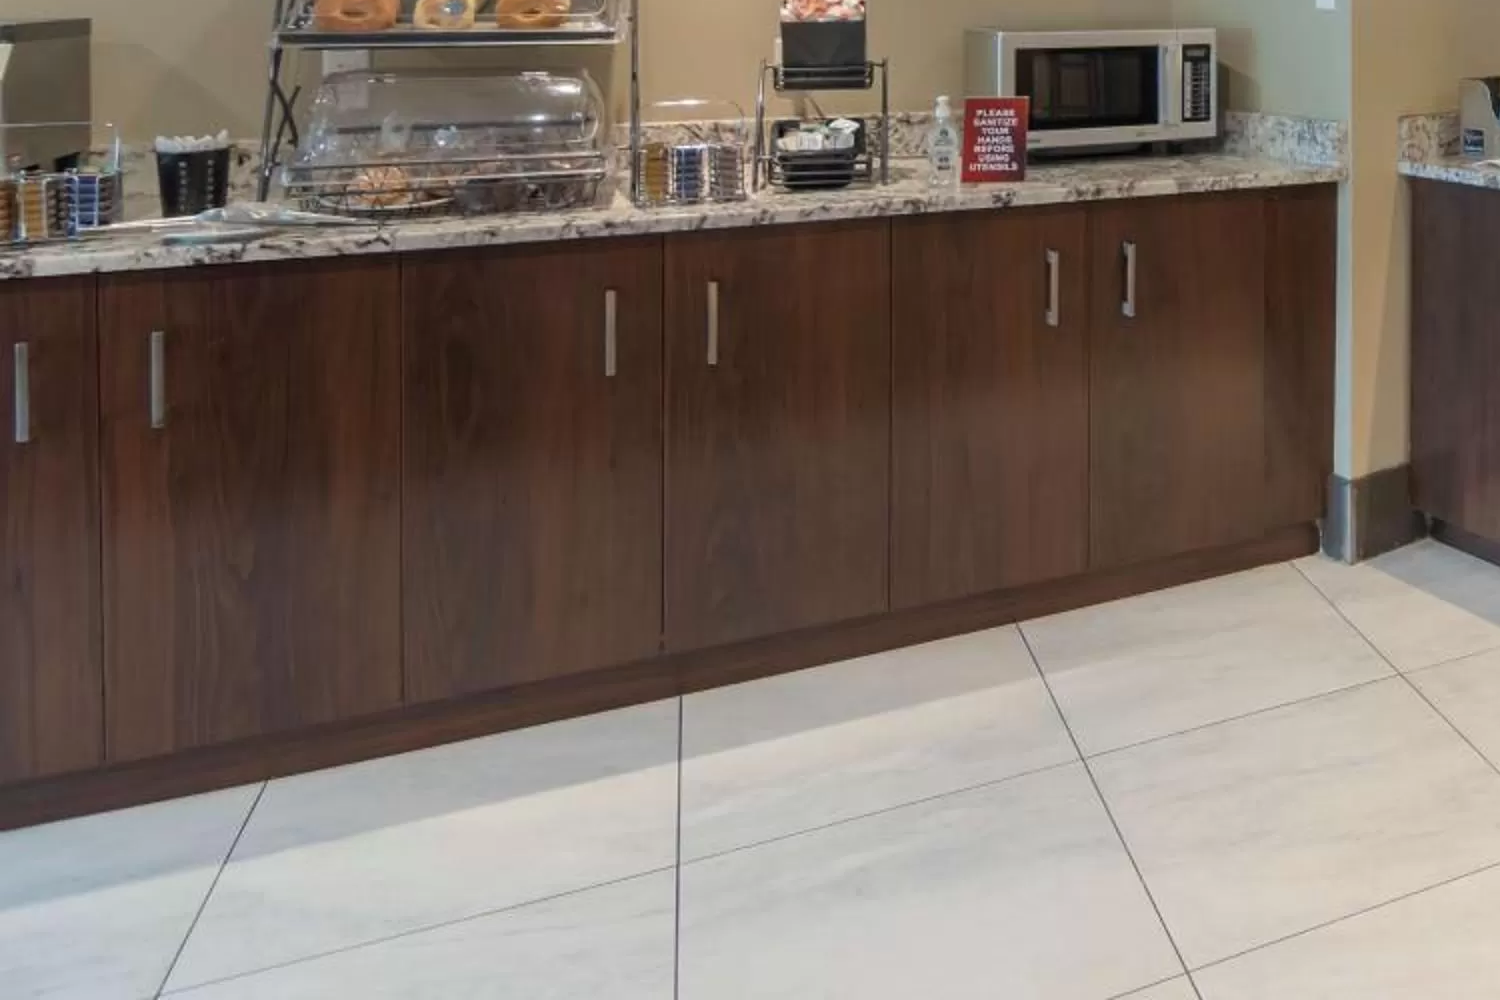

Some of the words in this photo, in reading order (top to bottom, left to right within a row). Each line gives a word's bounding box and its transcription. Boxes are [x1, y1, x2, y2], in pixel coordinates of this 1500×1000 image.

[975, 109, 1016, 117] PLEASE
[972, 118, 1018, 127] SANITIZE
[981, 127, 1010, 135] YOUR
[977, 136, 1013, 144] HANDS
[973, 145, 1014, 153] BEFORE
[978, 154, 1011, 162] USING
[969, 162, 1018, 171] UTENSILS
